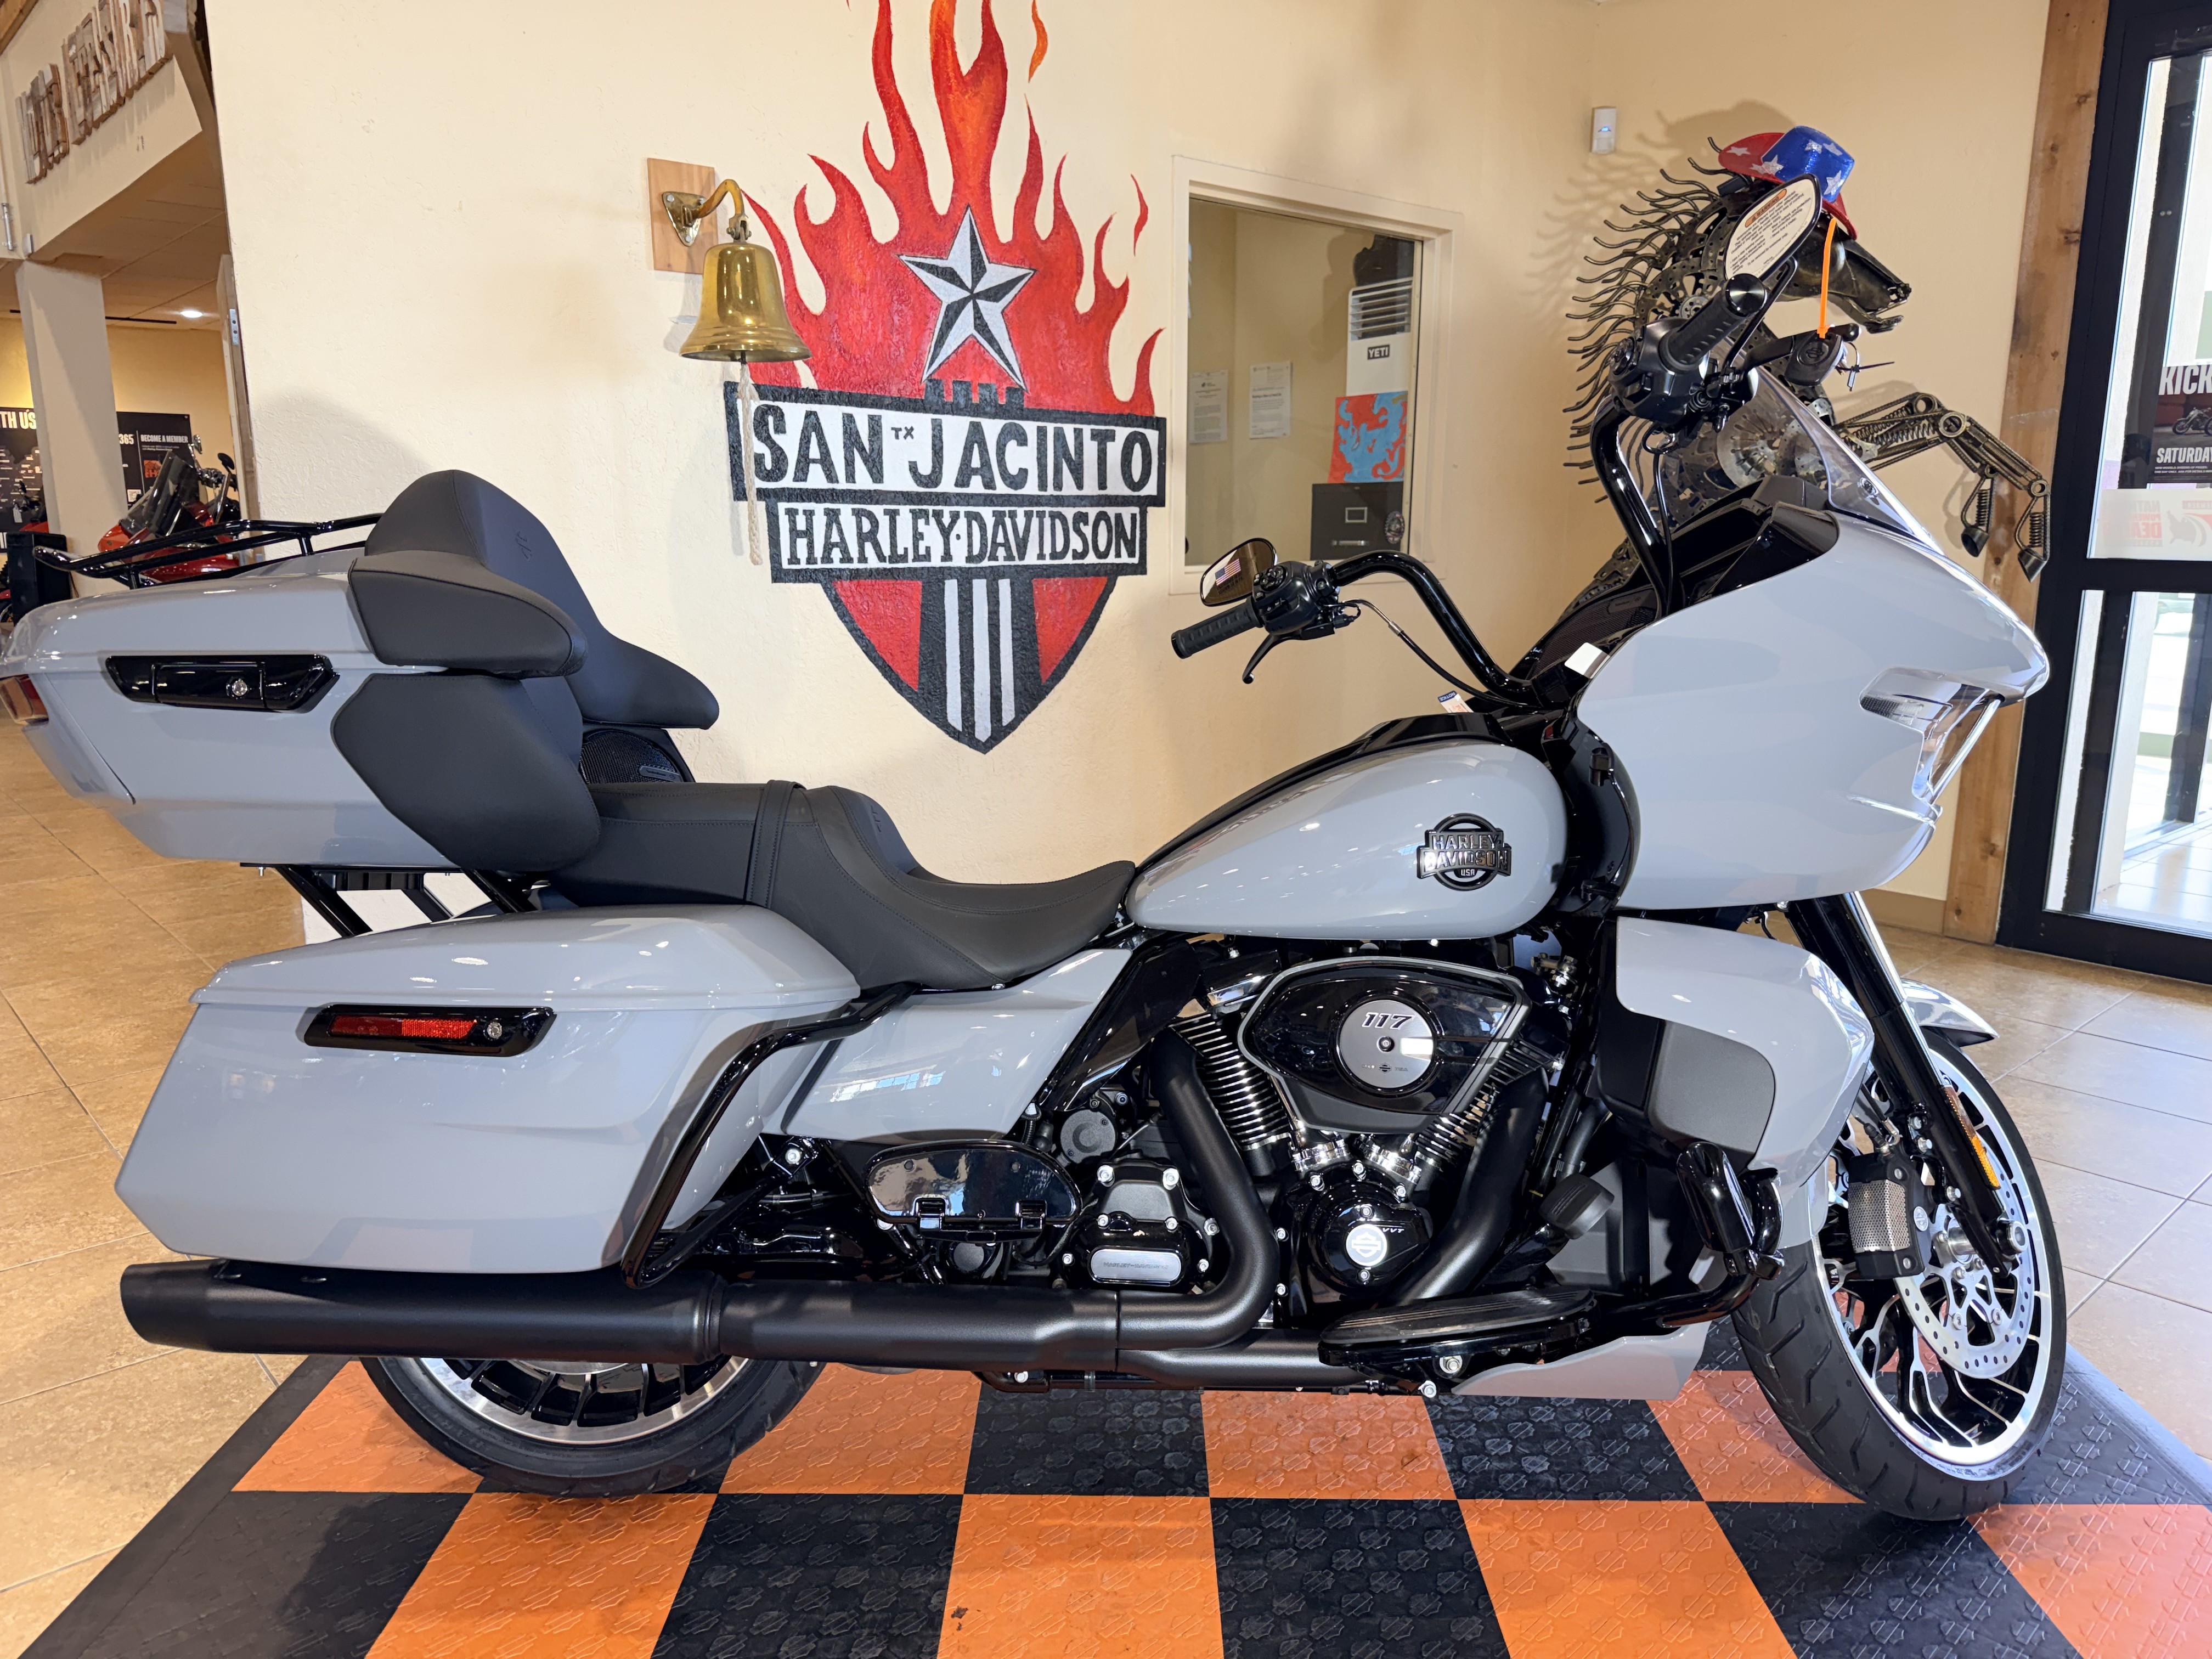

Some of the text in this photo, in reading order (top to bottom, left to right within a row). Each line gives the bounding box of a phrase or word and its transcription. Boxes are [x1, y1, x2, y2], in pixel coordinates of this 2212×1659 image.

[1757, 195, 1780, 217] WARNING
[1369, 347, 1389, 358] YETI
[19, 411, 37, 430] US
[119, 433, 134, 445] 365
[140, 435, 162, 443] BECOME
[754, 404, 884, 485] SAN
[891, 426, 915, 441] TX
[909, 418, 1152, 492] JACINTO
[2156, 447, 2212, 464] SATURDA
[1438, 692, 1456, 701] NOTICE
[1424, 850, 1508, 872] DAVIDSON
[1362, 1012, 1415, 1030] 117
